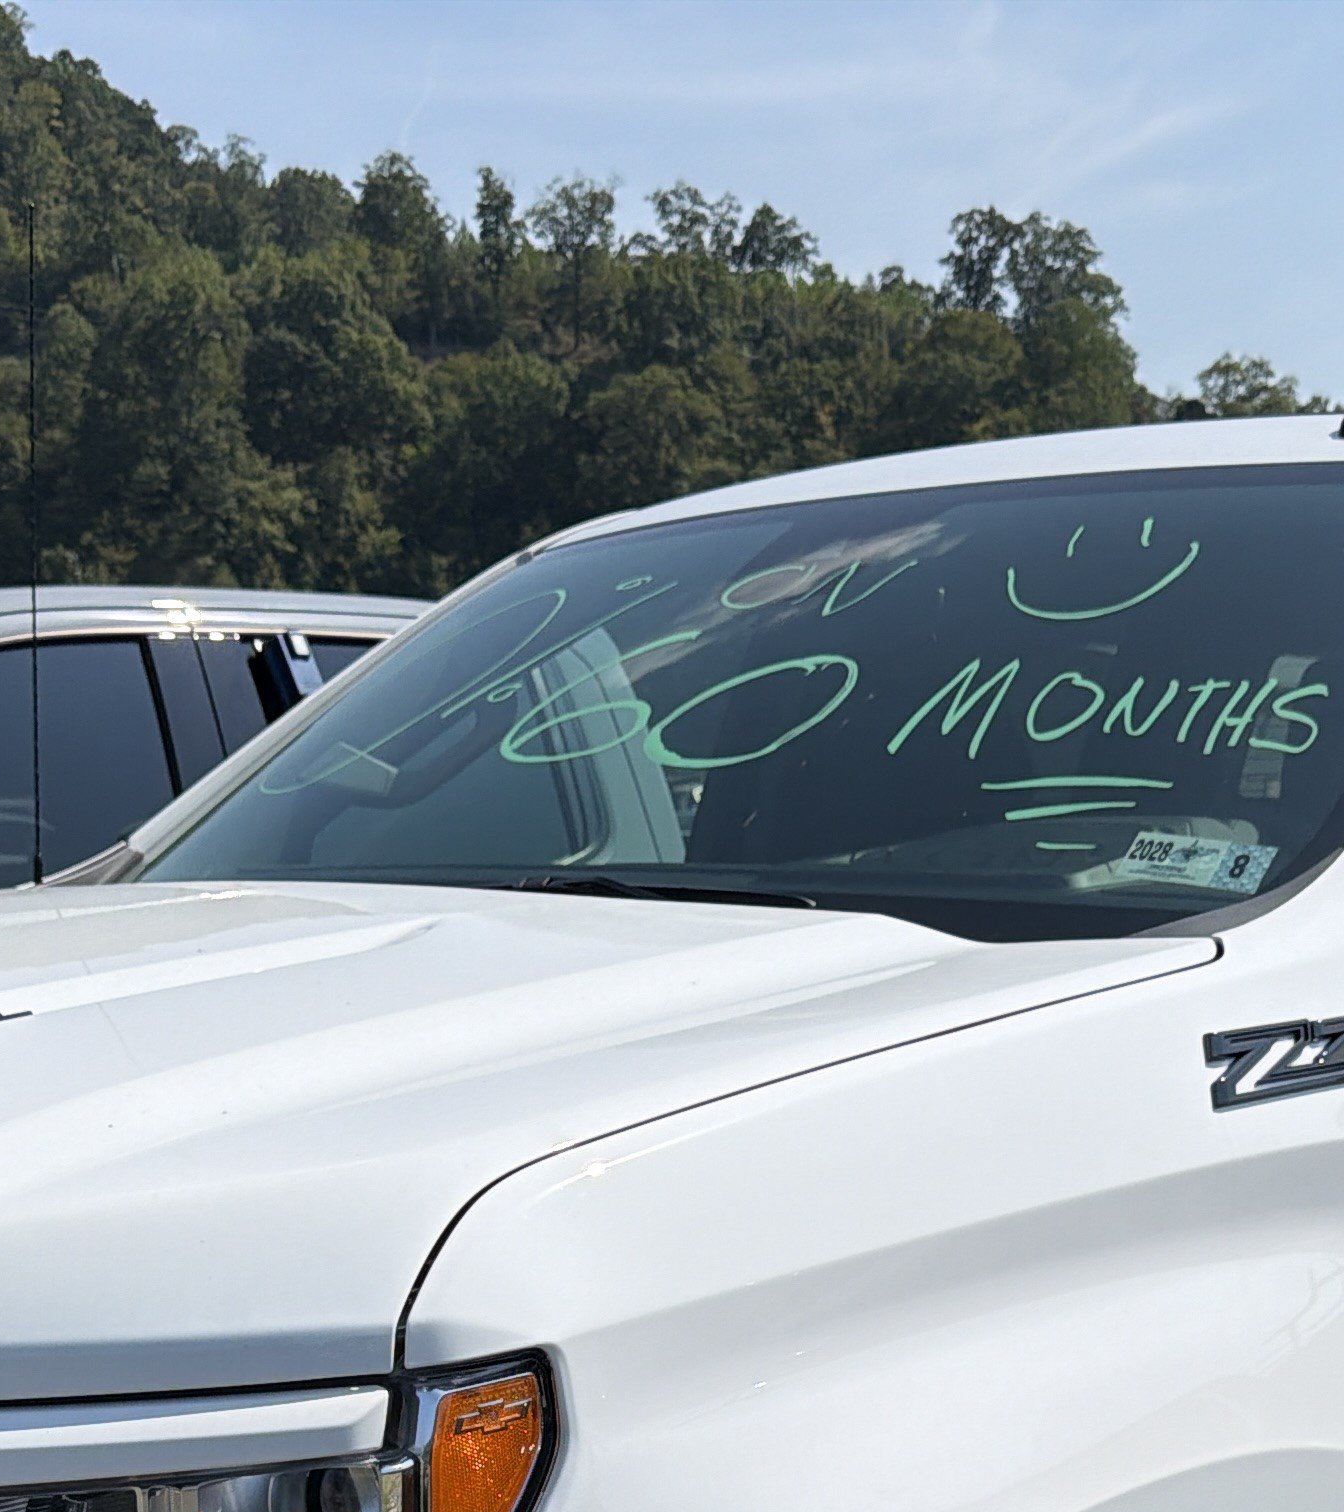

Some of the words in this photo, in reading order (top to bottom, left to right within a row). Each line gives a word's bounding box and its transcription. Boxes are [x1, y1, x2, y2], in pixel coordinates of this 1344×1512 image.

[720, 559, 919, 617] ON
[500, 628, 859, 769] 60
[886, 657, 1330, 758] MONTHS
[1128, 838, 1175, 863] 2028
[1228, 854, 1251, 879] 8
